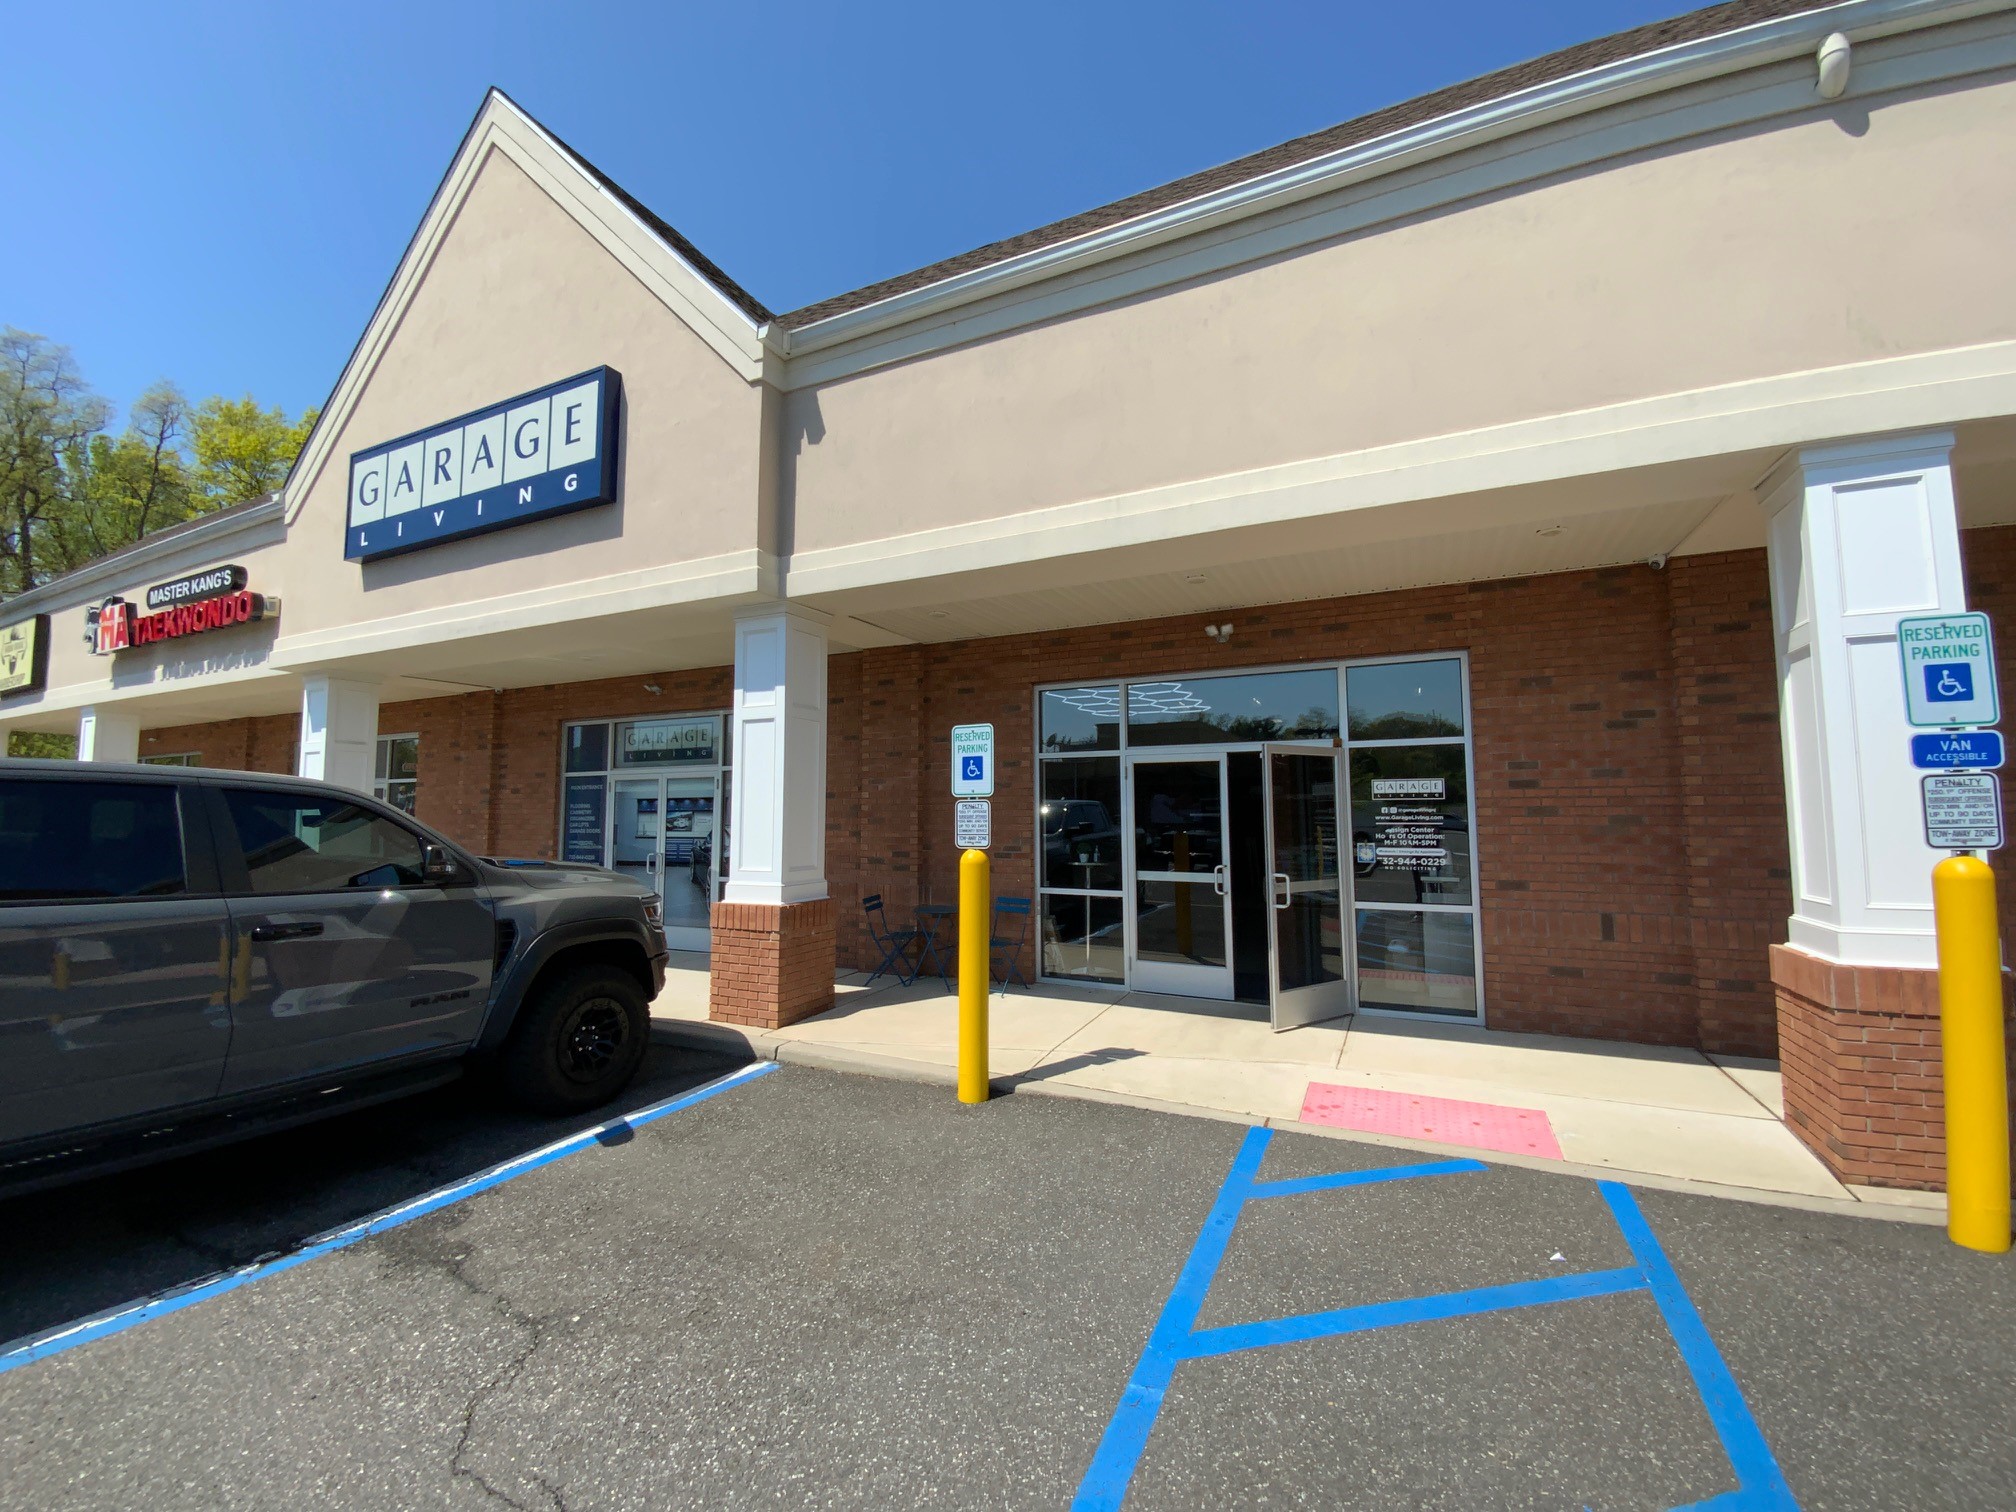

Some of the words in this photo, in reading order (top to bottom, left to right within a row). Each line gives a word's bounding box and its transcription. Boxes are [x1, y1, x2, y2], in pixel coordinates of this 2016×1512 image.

[359, 402, 583, 507] GARAGE
[360, 473, 578, 547] LIVING
[150, 581, 190, 605] MASTER
[191, 569, 232, 594] KANG'S
[133, 590, 252, 646] TAEKWONDO
[1904, 624, 1983, 642] RESERVED
[1911, 643, 1980, 660] PARKING
[628, 728, 709, 746] GARAGE
[955, 731, 990, 742] RESERVED
[957, 743, 988, 754] PARKING
[1940, 739, 1972, 751] VAN
[629, 750, 708, 759] LIVING
[1926, 752, 1988, 762] ACCESSIBLE
[1376, 781, 1439, 791] GARAGE
[1934, 778, 1982, 787] PENALTY
